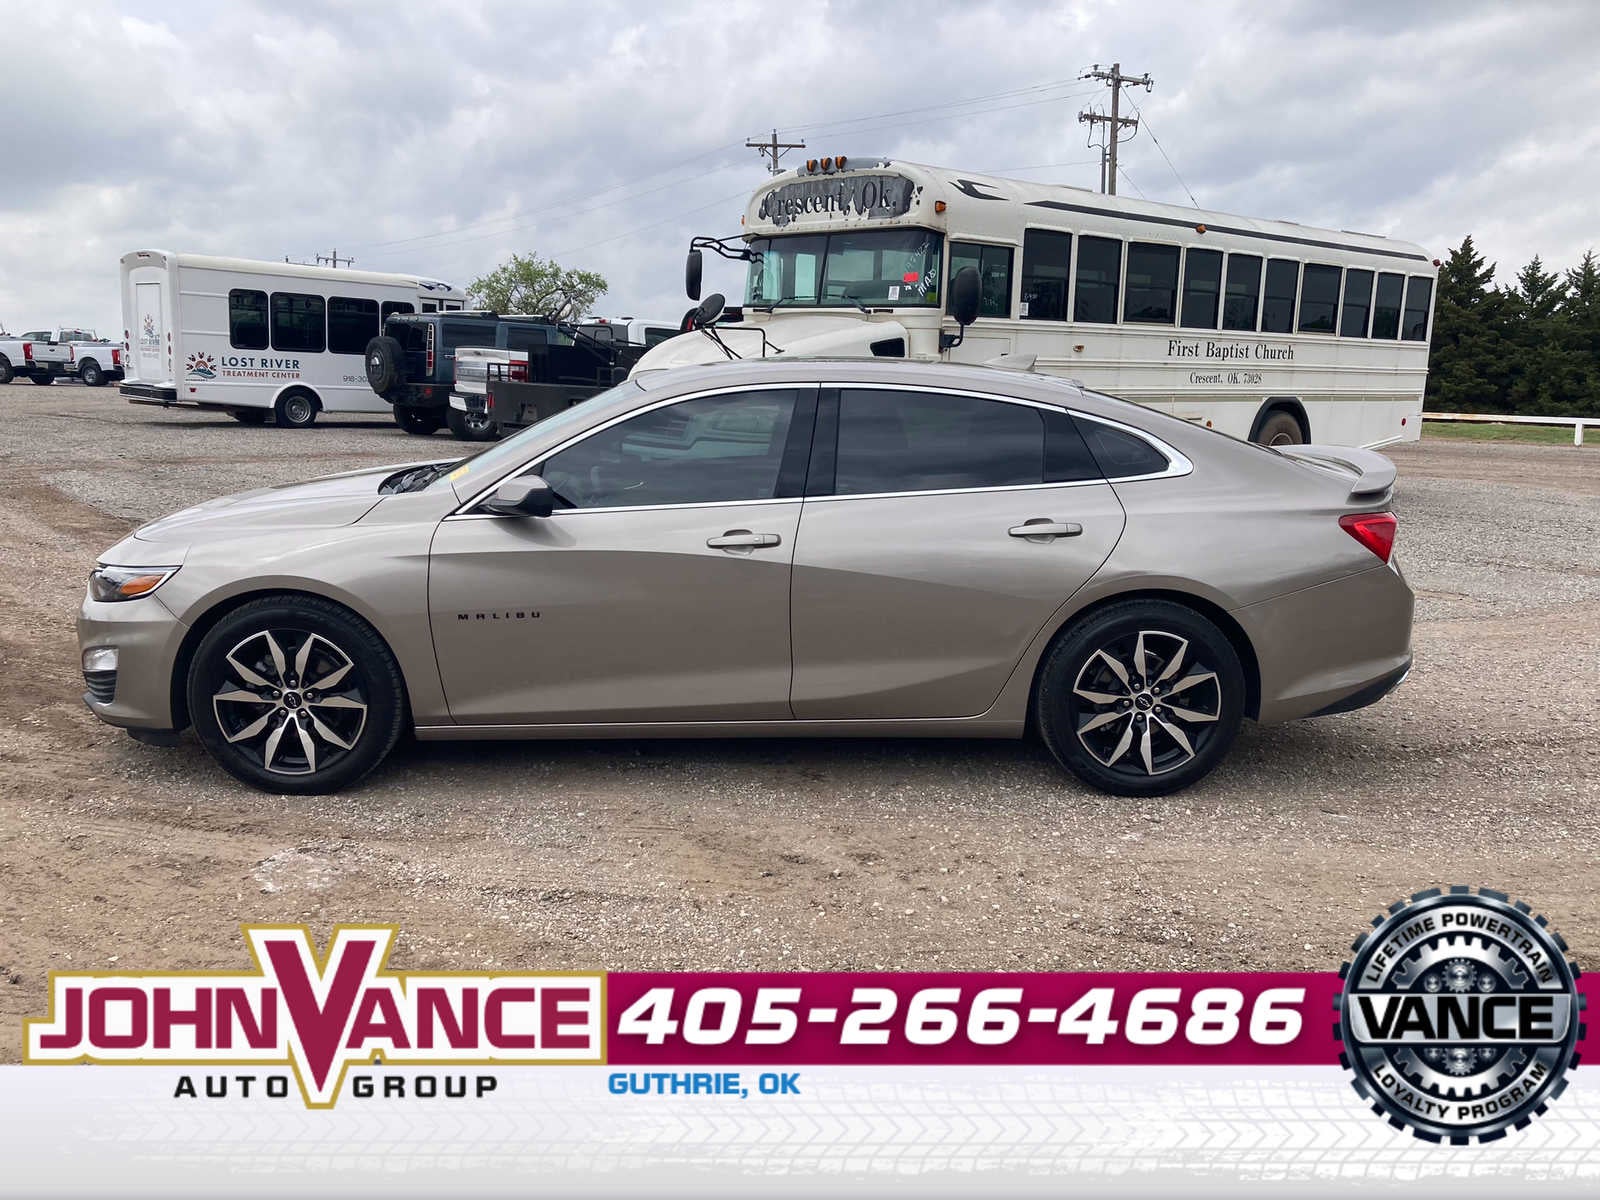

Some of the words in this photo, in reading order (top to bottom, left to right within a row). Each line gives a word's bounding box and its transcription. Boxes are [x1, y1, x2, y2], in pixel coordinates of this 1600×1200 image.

[1167, 340, 1200, 357] First
[1206, 341, 1250, 361] Baptist
[1255, 343, 1294, 360] Church
[221, 356, 258, 367] LOST
[261, 359, 300, 369] RIVER
[222, 370, 270, 379] TREATMENT
[271, 372, 300, 380] CENTER
[342, 375, 370, 384] 918-30
[457, 611, 541, 621] MALIBU
